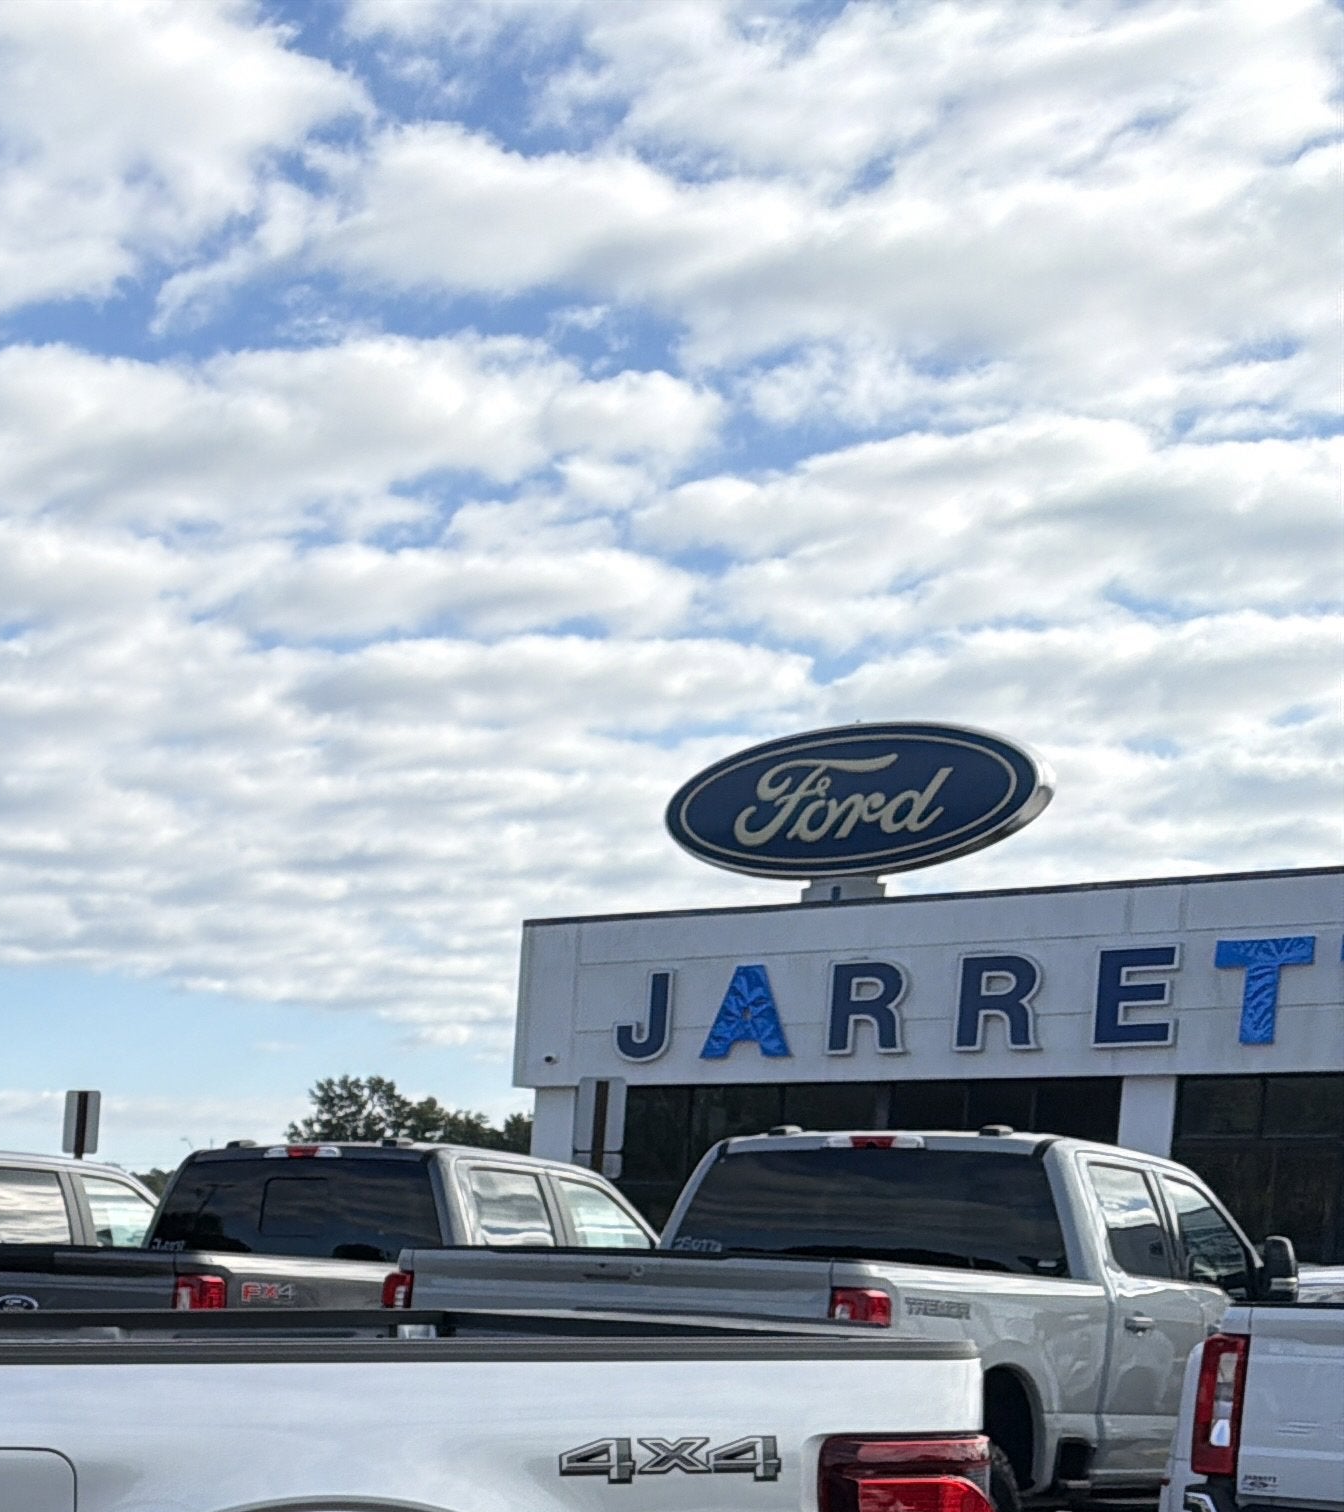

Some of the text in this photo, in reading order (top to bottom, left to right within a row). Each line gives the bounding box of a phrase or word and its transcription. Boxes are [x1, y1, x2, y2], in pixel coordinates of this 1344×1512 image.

[733, 752, 954, 847] Ford
[613, 933, 1344, 1062] JARRET
[241, 1282, 294, 1303] FX4
